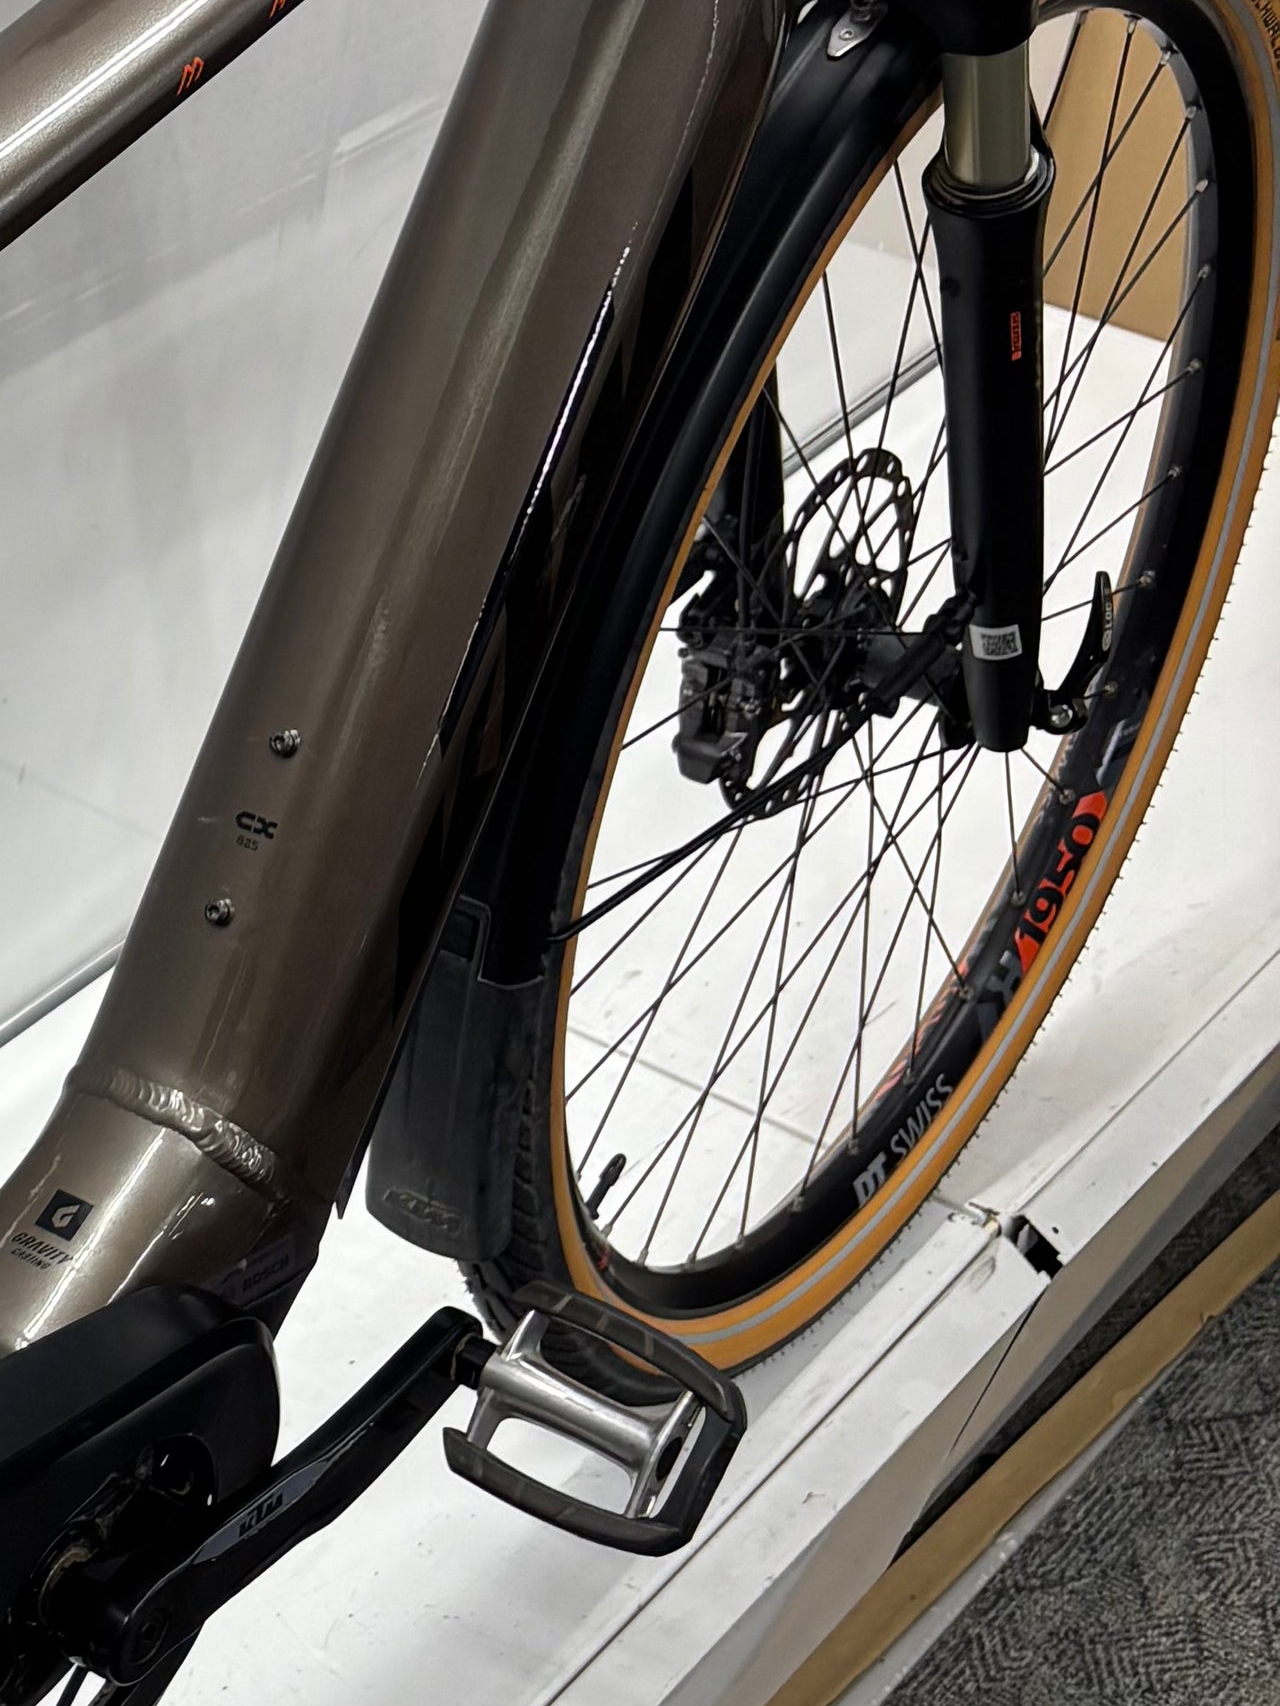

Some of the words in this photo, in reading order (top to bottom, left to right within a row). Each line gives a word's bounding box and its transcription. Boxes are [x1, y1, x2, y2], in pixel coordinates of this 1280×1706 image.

[236, 811, 279, 840] CX
[889, 1072, 954, 1163] SWISS
[11, 1232, 74, 1265] GRAVITY
[238, 1493, 283, 1537] KTM
